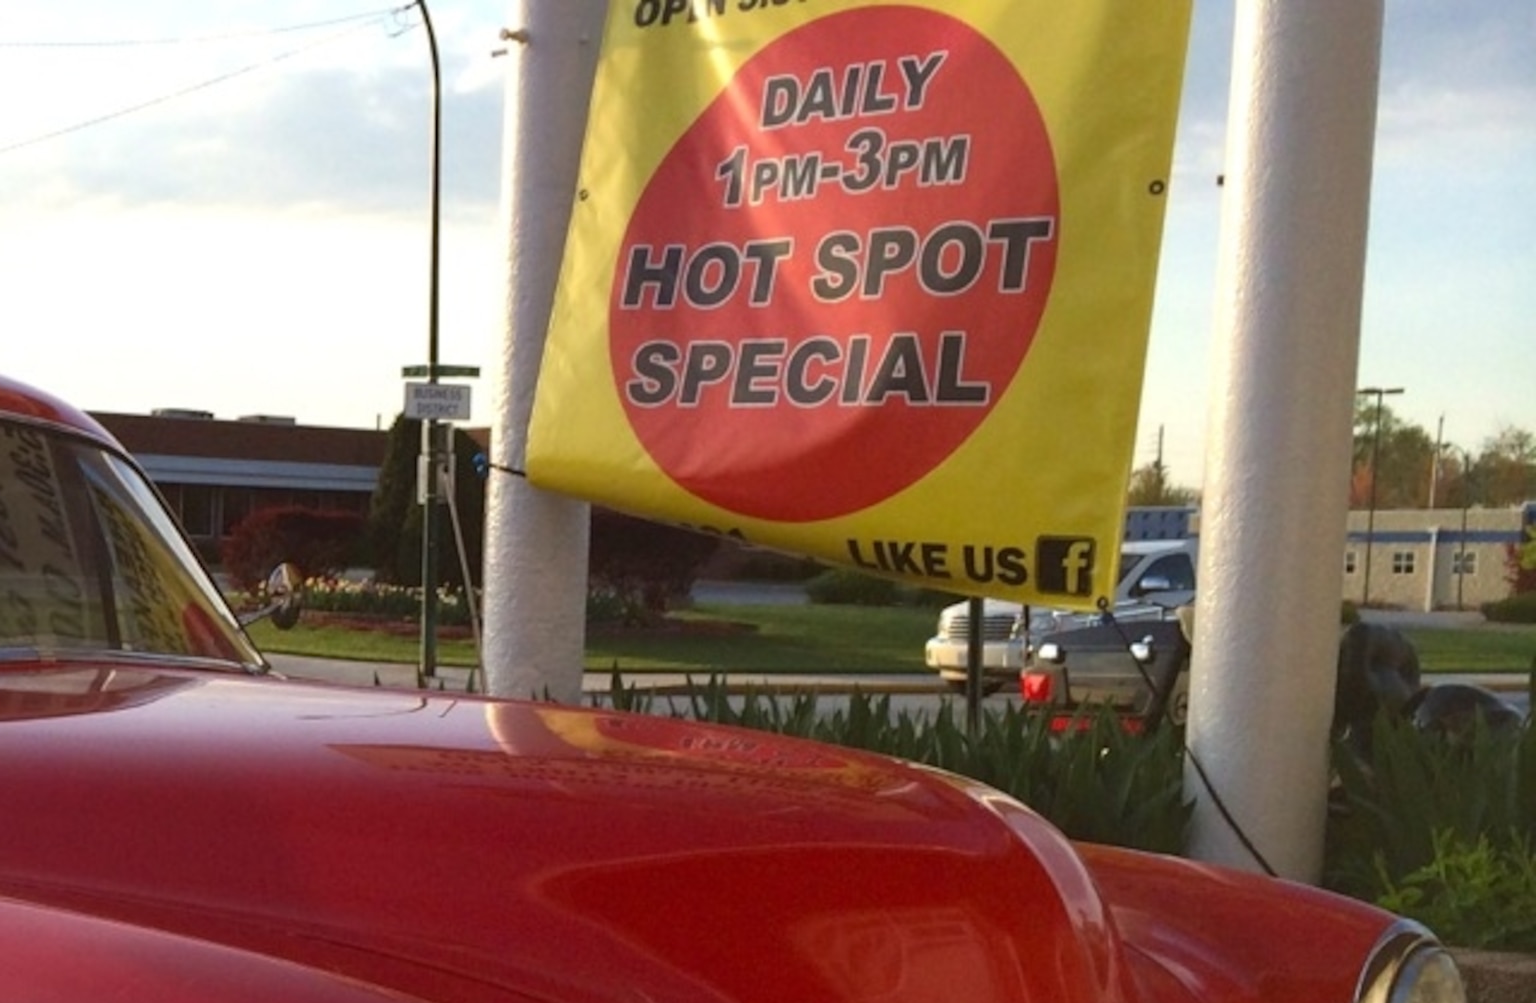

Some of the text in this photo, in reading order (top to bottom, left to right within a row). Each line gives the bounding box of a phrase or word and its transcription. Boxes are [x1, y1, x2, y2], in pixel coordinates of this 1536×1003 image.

[759, 51, 947, 130] DAILY
[716, 127, 970, 207] 1PM-3PM
[621, 217, 1054, 309] HOT SPOT
[626, 332, 991, 407] SPECIAL
[846, 538, 951, 579] LIKE
[963, 545, 1029, 586] US
